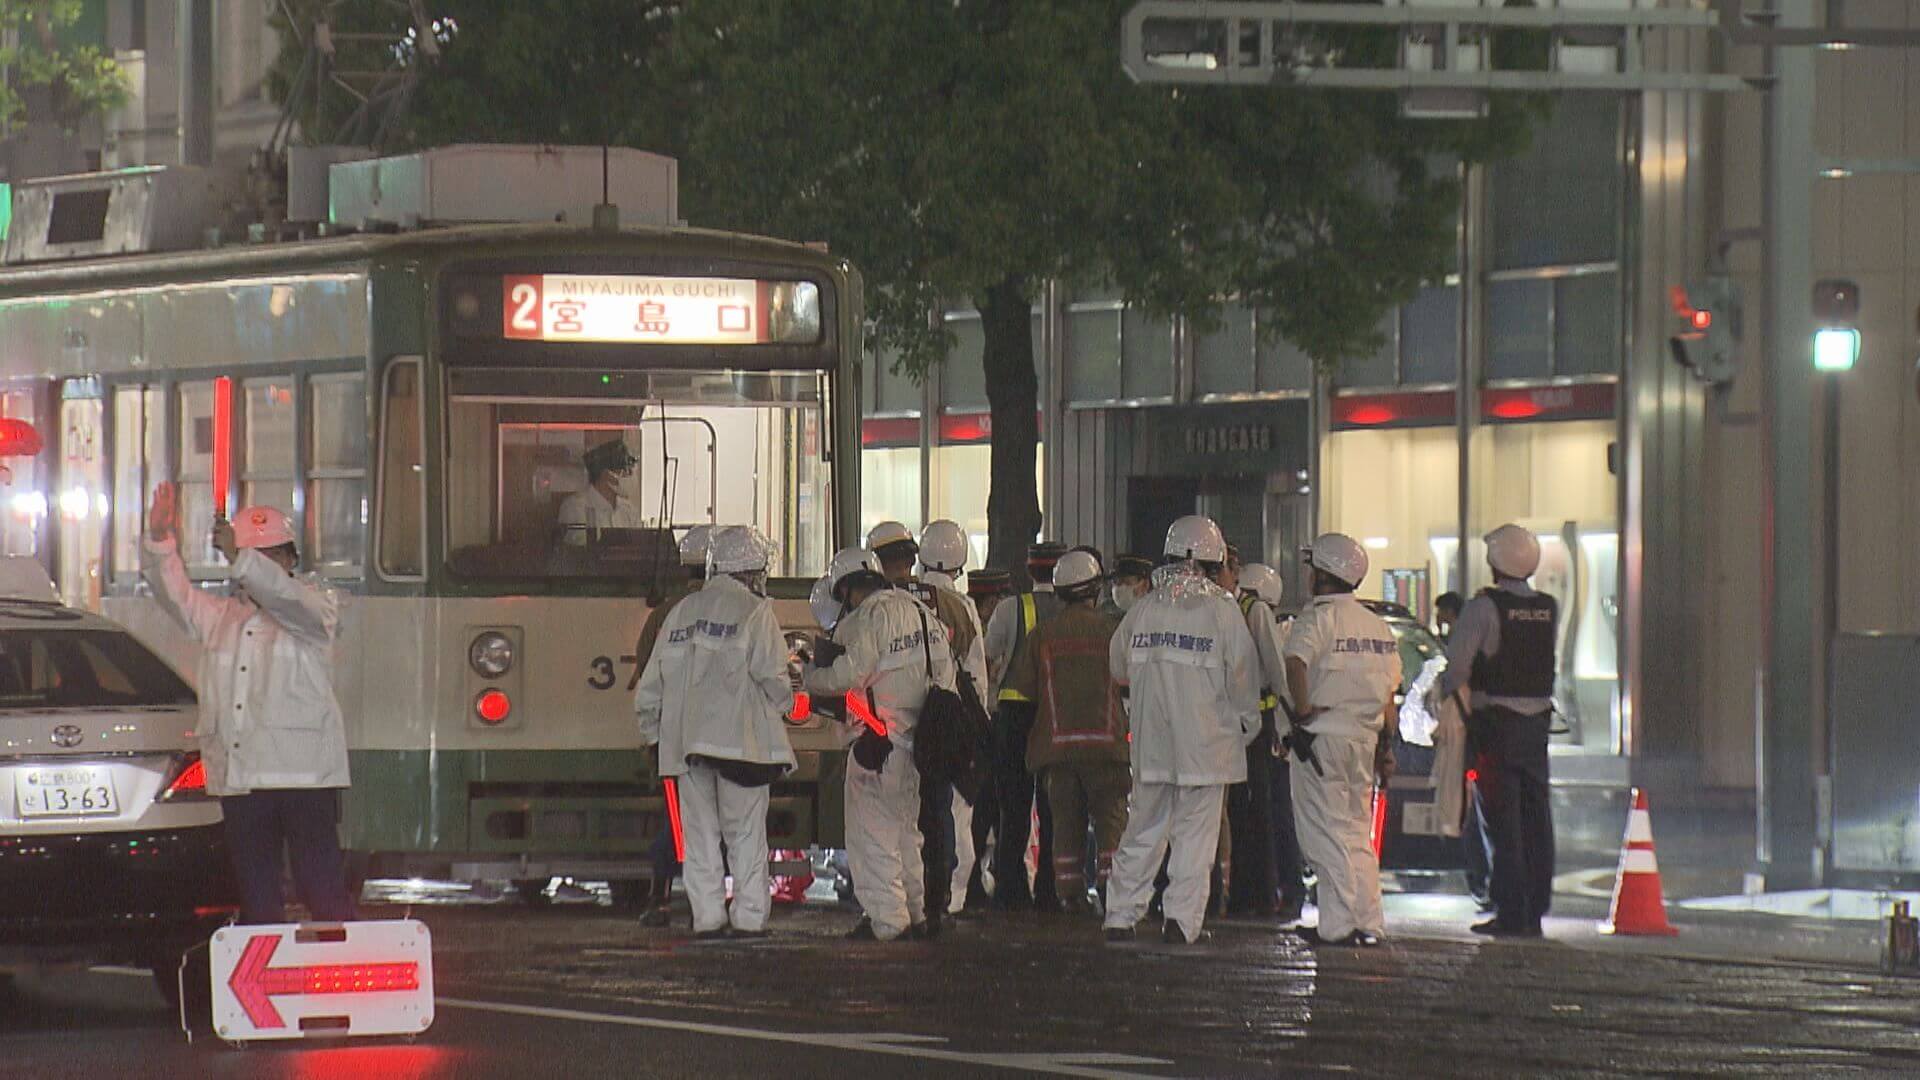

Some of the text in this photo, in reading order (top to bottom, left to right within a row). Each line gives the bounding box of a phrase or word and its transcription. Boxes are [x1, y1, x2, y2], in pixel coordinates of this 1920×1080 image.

[562, 281, 738, 298] MIYAJIMA GUCHI
[511, 284, 537, 330] 2
[549, 300, 751, 334] 宮島口
[1508, 608, 1551, 621] POLICE
[1132, 631, 1214, 652] 広島県警察
[43, 787, 110, 811] 13-63
